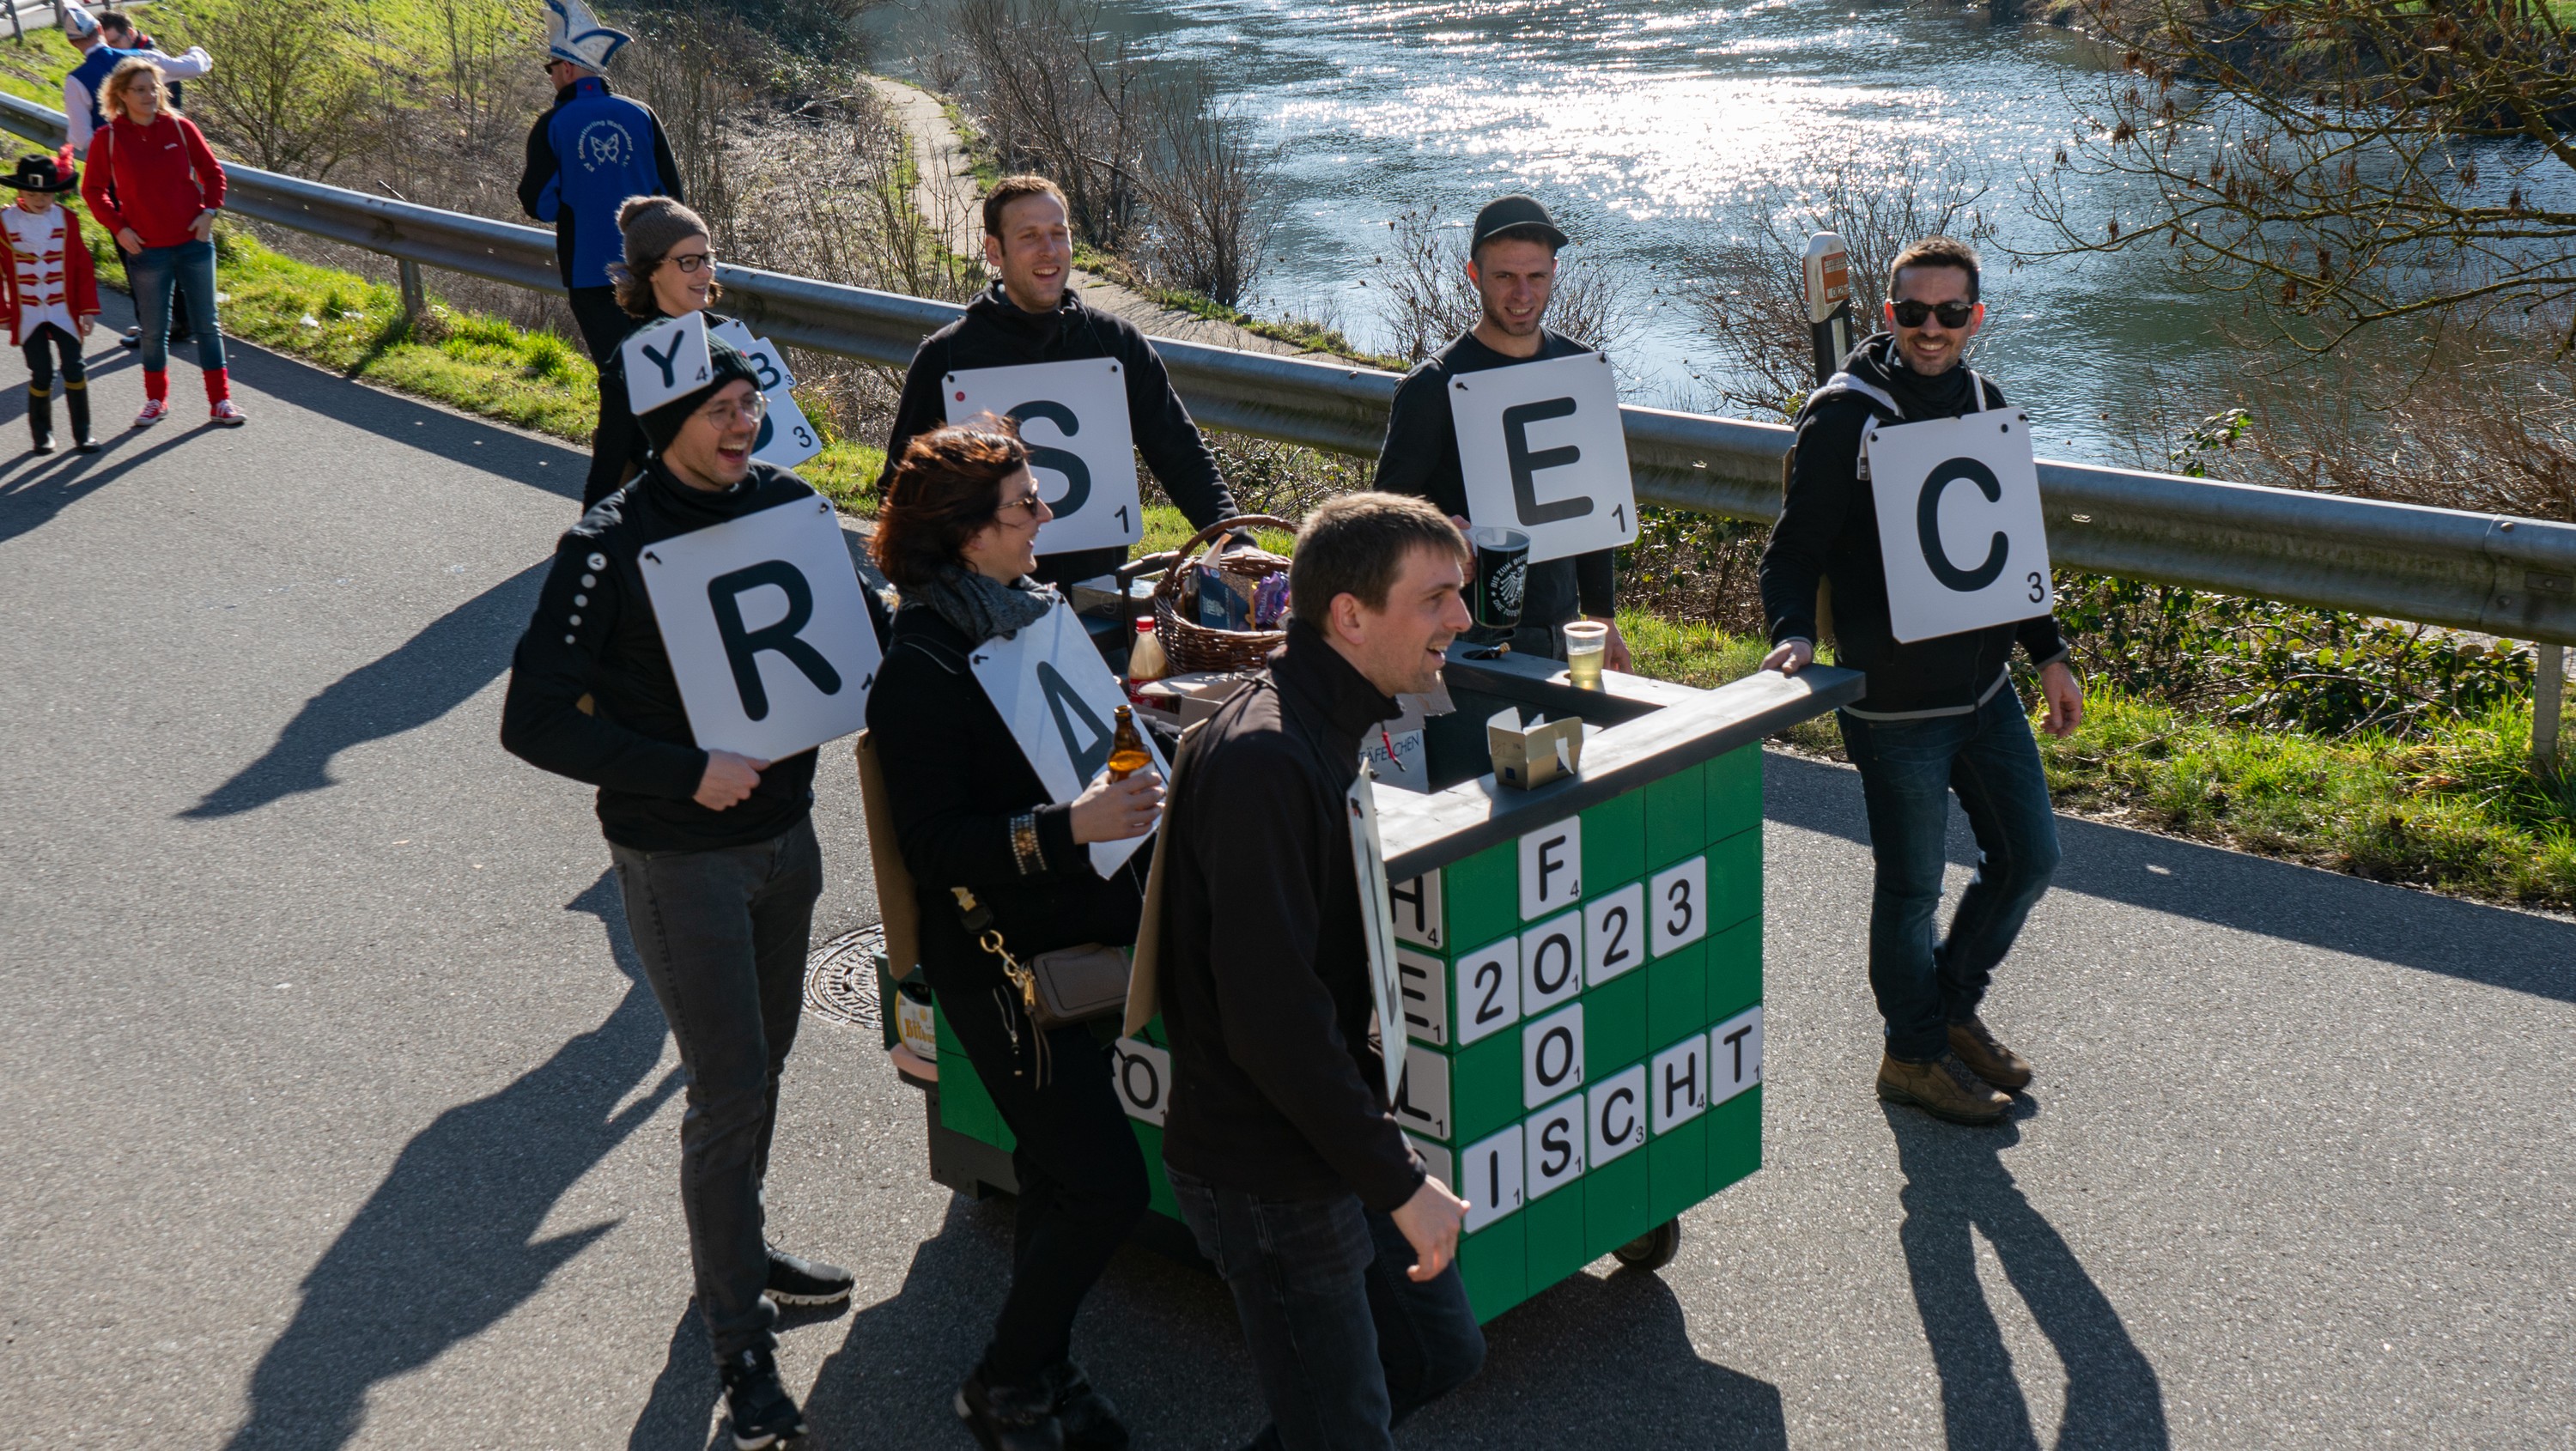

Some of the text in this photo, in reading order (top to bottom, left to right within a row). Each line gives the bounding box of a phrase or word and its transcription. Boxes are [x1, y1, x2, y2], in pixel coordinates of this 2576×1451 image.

[584, 162, 595, 172] KV
[641, 329, 709, 388] Y 4
[747, 352, 781, 392] B
[793, 425, 812, 448] 3
[1002, 399, 1129, 534] S 1
[1502, 396, 1626, 533] E 1
[1917, 457, 2045, 604] C 3
[1491, 575, 1501, 588] BIS
[1496, 562, 1513, 577] ZUM
[707, 560, 842, 722] R
[1538, 835, 1566, 902] F
